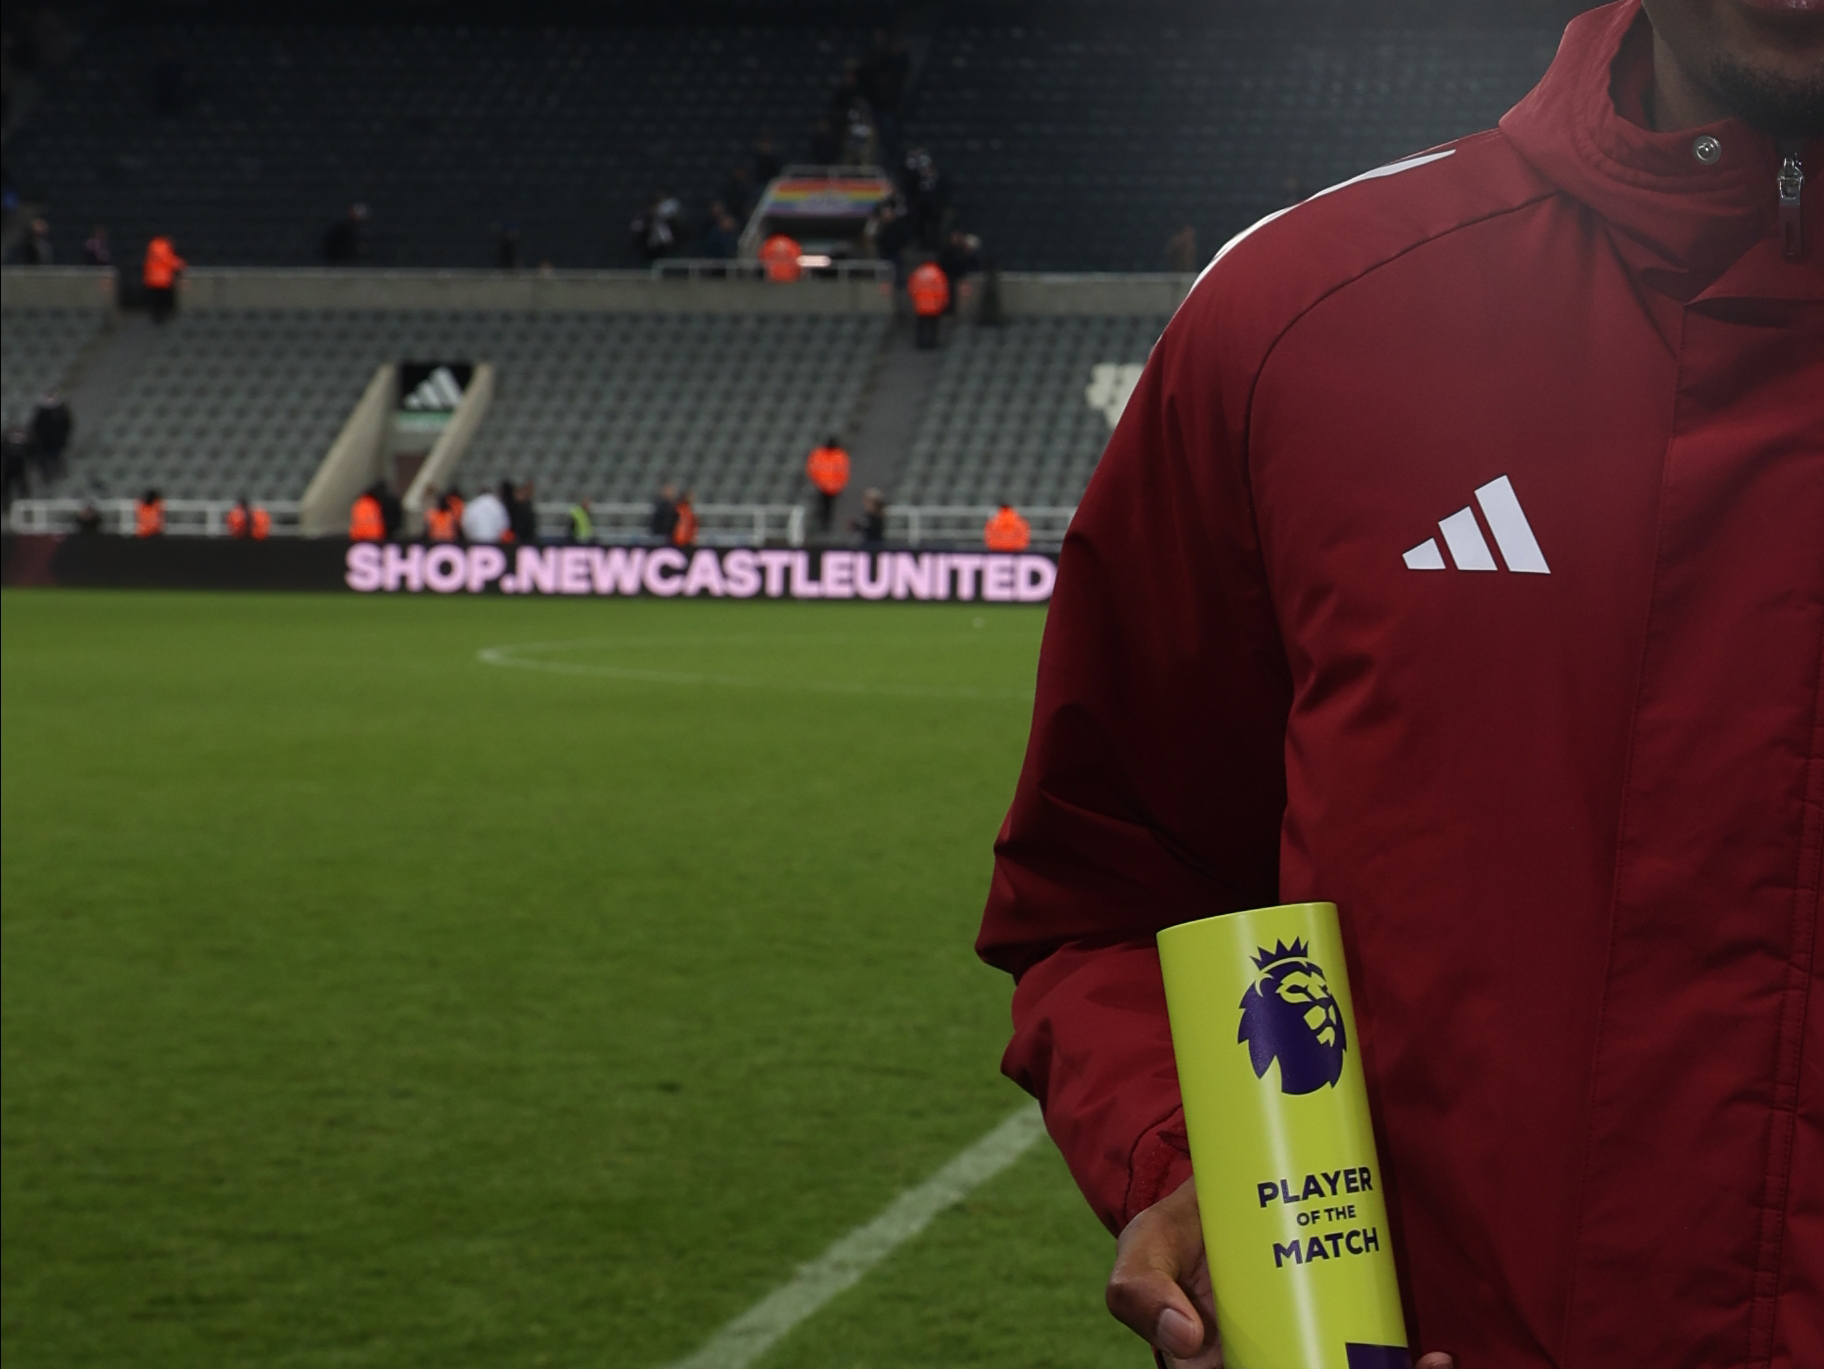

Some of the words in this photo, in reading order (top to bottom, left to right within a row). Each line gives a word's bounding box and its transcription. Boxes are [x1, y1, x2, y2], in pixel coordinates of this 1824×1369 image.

[1257, 1167, 1374, 1208] PLAYER
[1296, 1209, 1320, 1226] OF
[1324, 1205, 1356, 1222] THE
[1272, 1227, 1380, 1268] MATCH
